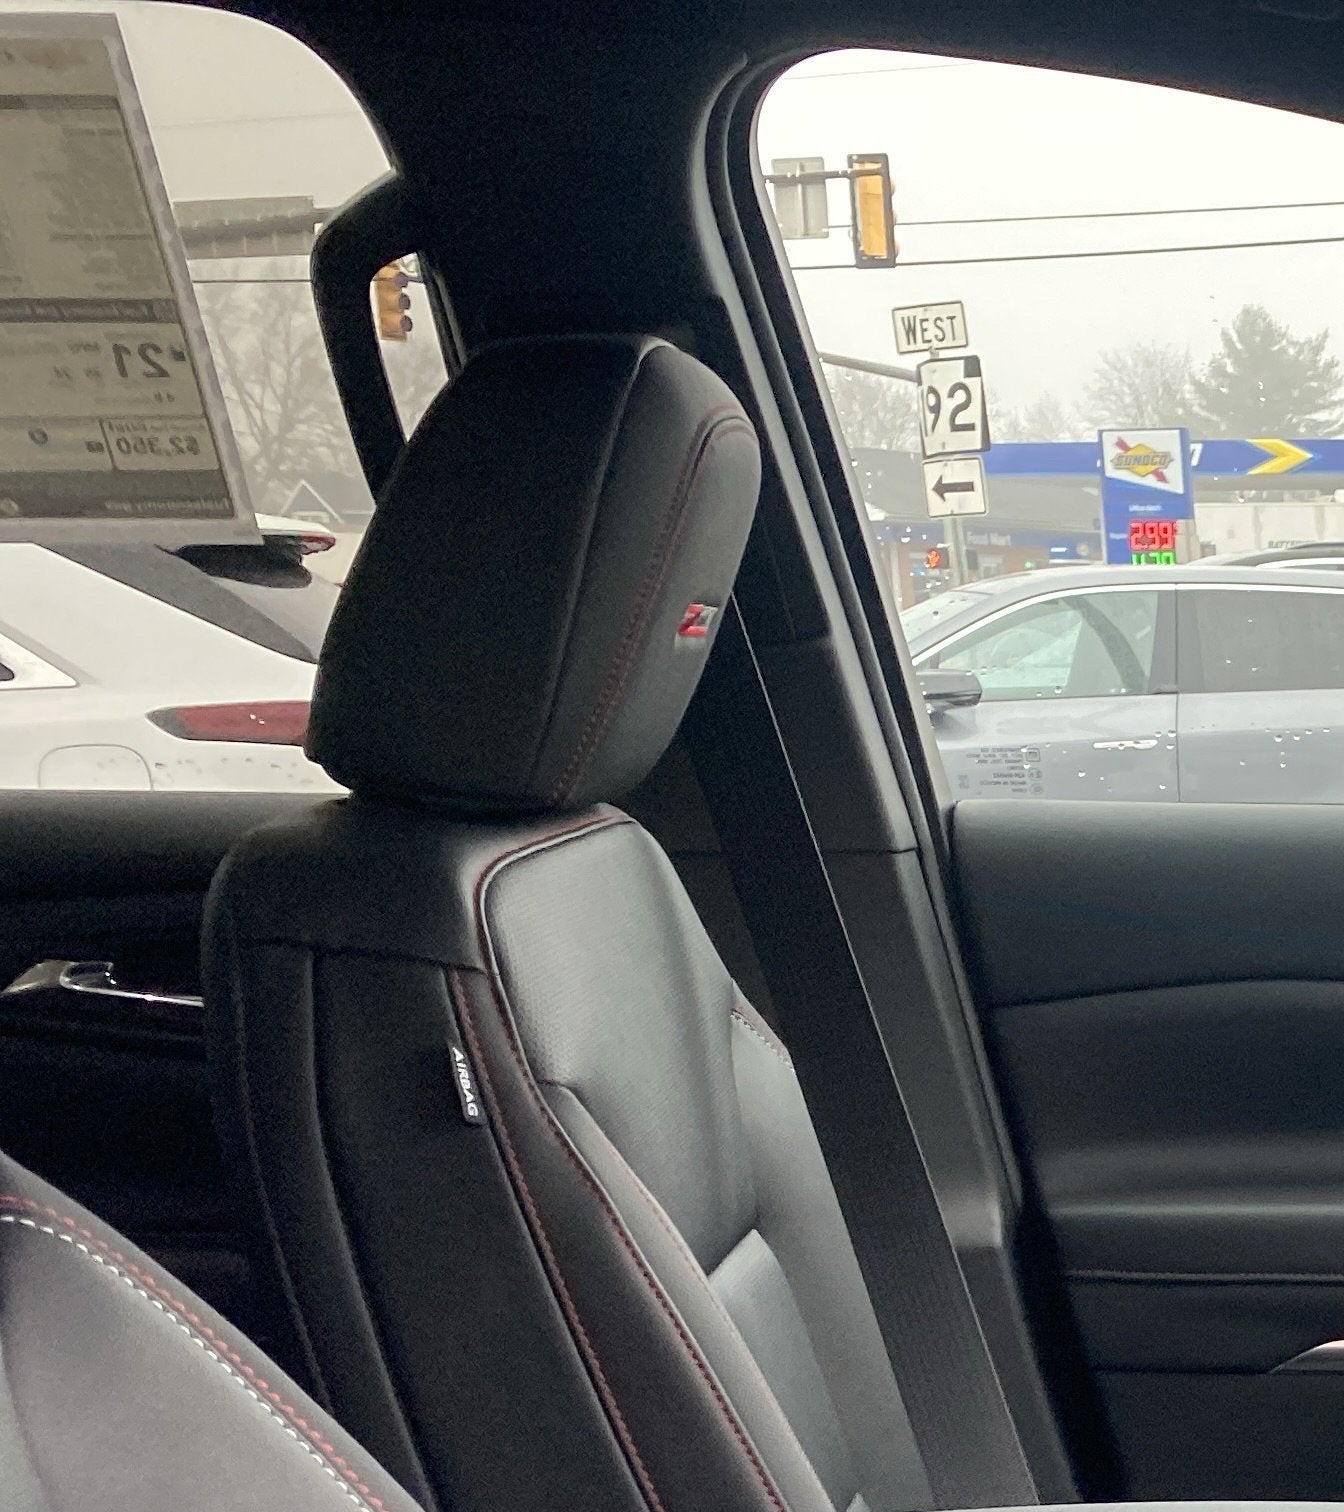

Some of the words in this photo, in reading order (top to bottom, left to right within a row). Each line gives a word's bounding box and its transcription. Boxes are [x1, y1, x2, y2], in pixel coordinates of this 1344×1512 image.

[901, 315, 957, 346] WEST
[1114, 452, 1171, 470] SUNOCO
[452, 1046, 479, 1117] AIRBAG
